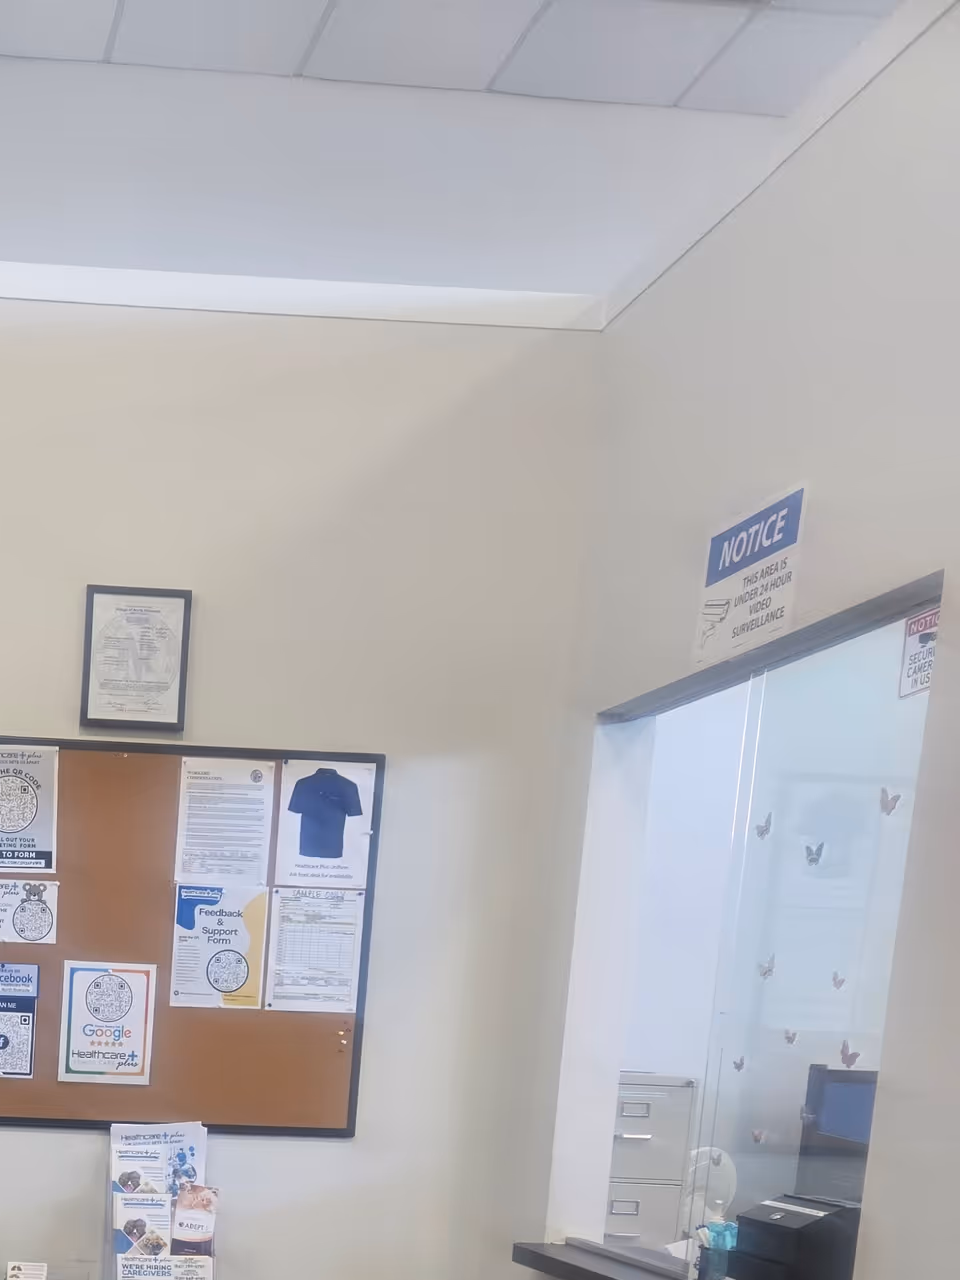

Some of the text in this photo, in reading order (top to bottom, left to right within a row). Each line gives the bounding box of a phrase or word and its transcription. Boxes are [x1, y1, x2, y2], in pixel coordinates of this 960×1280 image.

[719, 507, 788, 571] NOTICE
[742, 556, 788, 588] THIS AREA IS
[734, 571, 792, 607] UNDER 24 HOUR
[749, 596, 772, 616] VIDEO
[731, 606, 785, 639] SURVEILLANCE
[911, 678, 918, 689] IN
[24, 772, 42, 790] CODE
[2, 888, 19, 898] plus
[199, 908, 243, 917] Feedback
[217, 918, 224, 926] &
[202, 926, 239, 936] Support
[207, 936, 231, 944] Form
[82, 1023, 132, 1041] Google
[71, 1050, 126, 1059] Healthcare
[116, 1058, 139, 1070] plus
[121, 1131, 185, 1141] Healthcare plus
[185, 1222, 204, 1230] ADEPT
